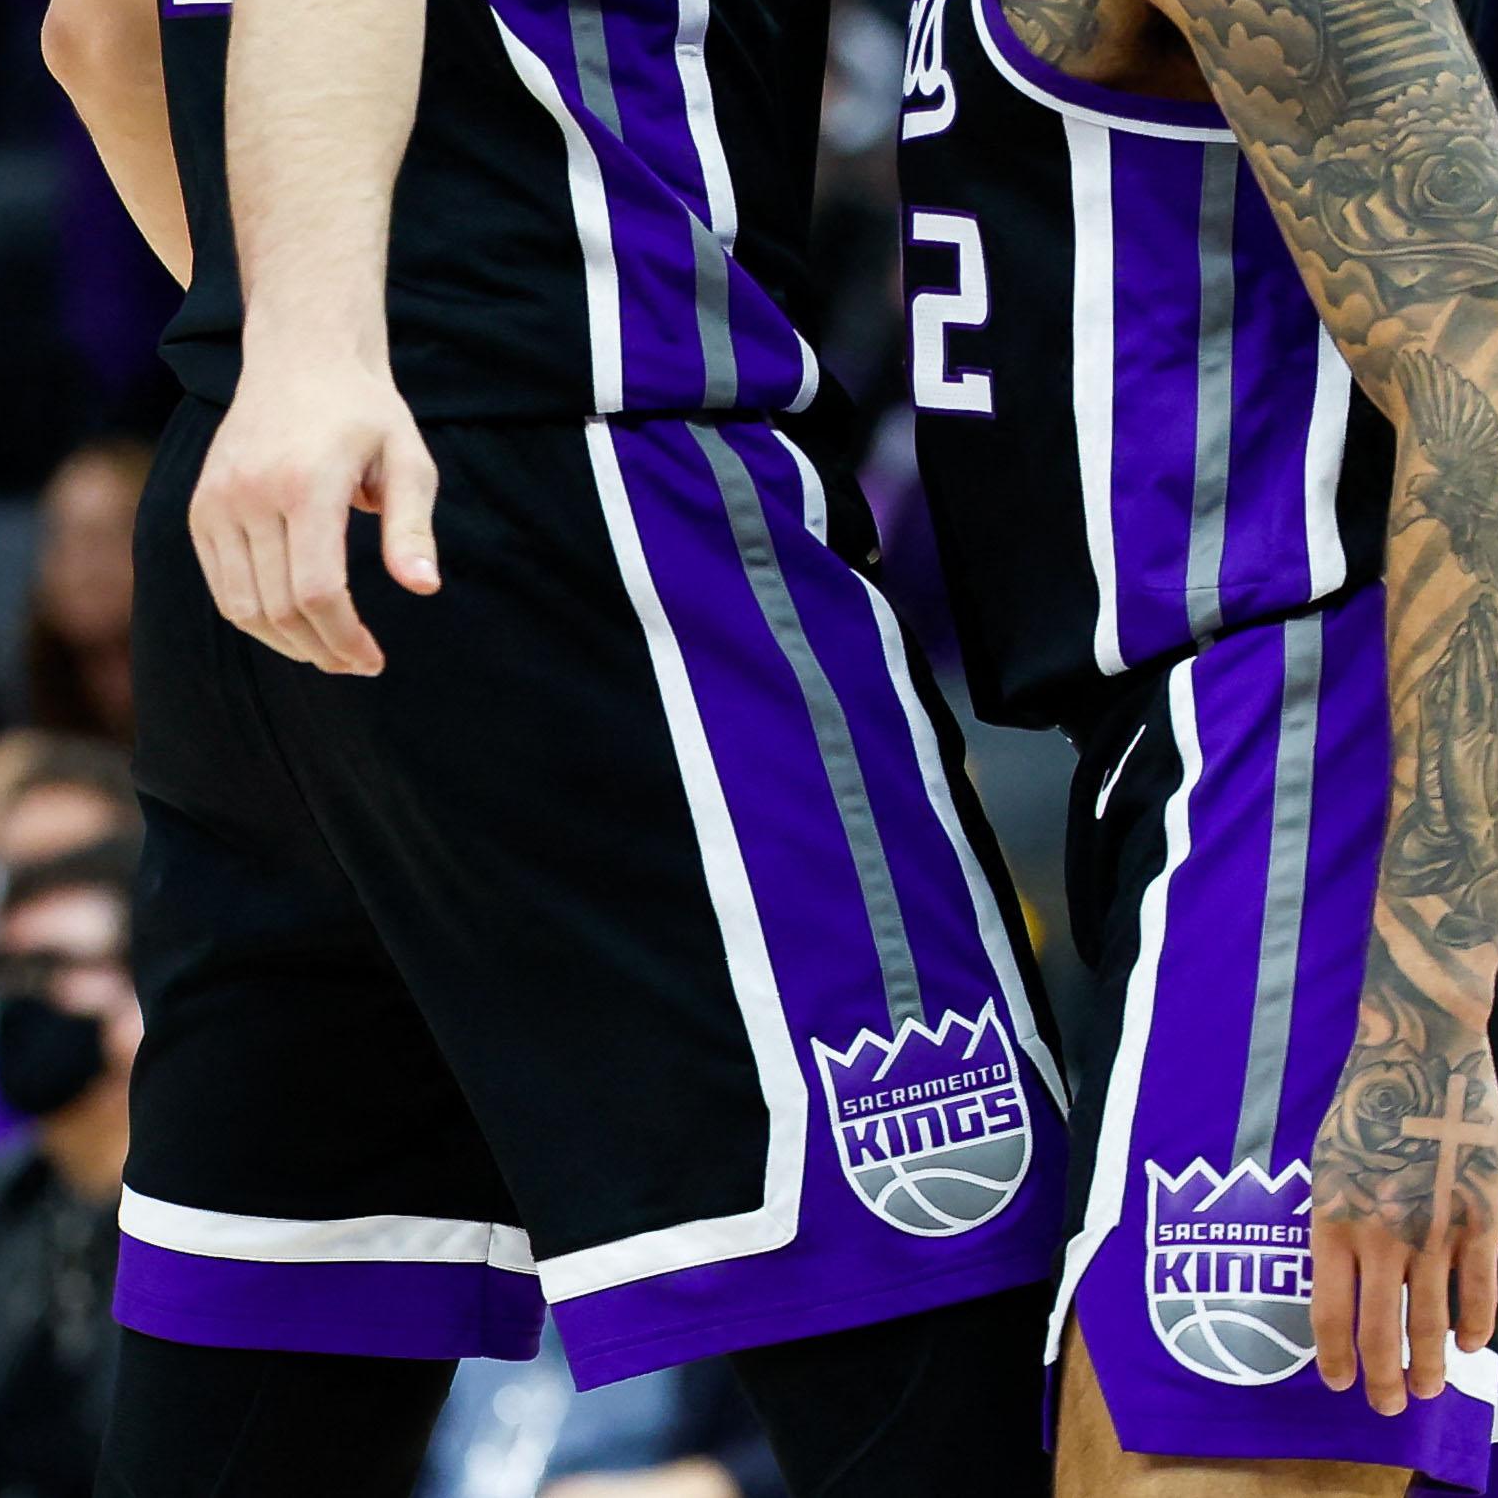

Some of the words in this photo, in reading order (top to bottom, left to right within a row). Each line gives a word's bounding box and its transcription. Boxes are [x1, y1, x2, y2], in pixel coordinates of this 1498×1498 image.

[841, 1061, 1007, 1118] SACRAMENTO
[840, 1086, 1025, 1169] KINGS
[1157, 1222, 1312, 1244] SACRAMEN
